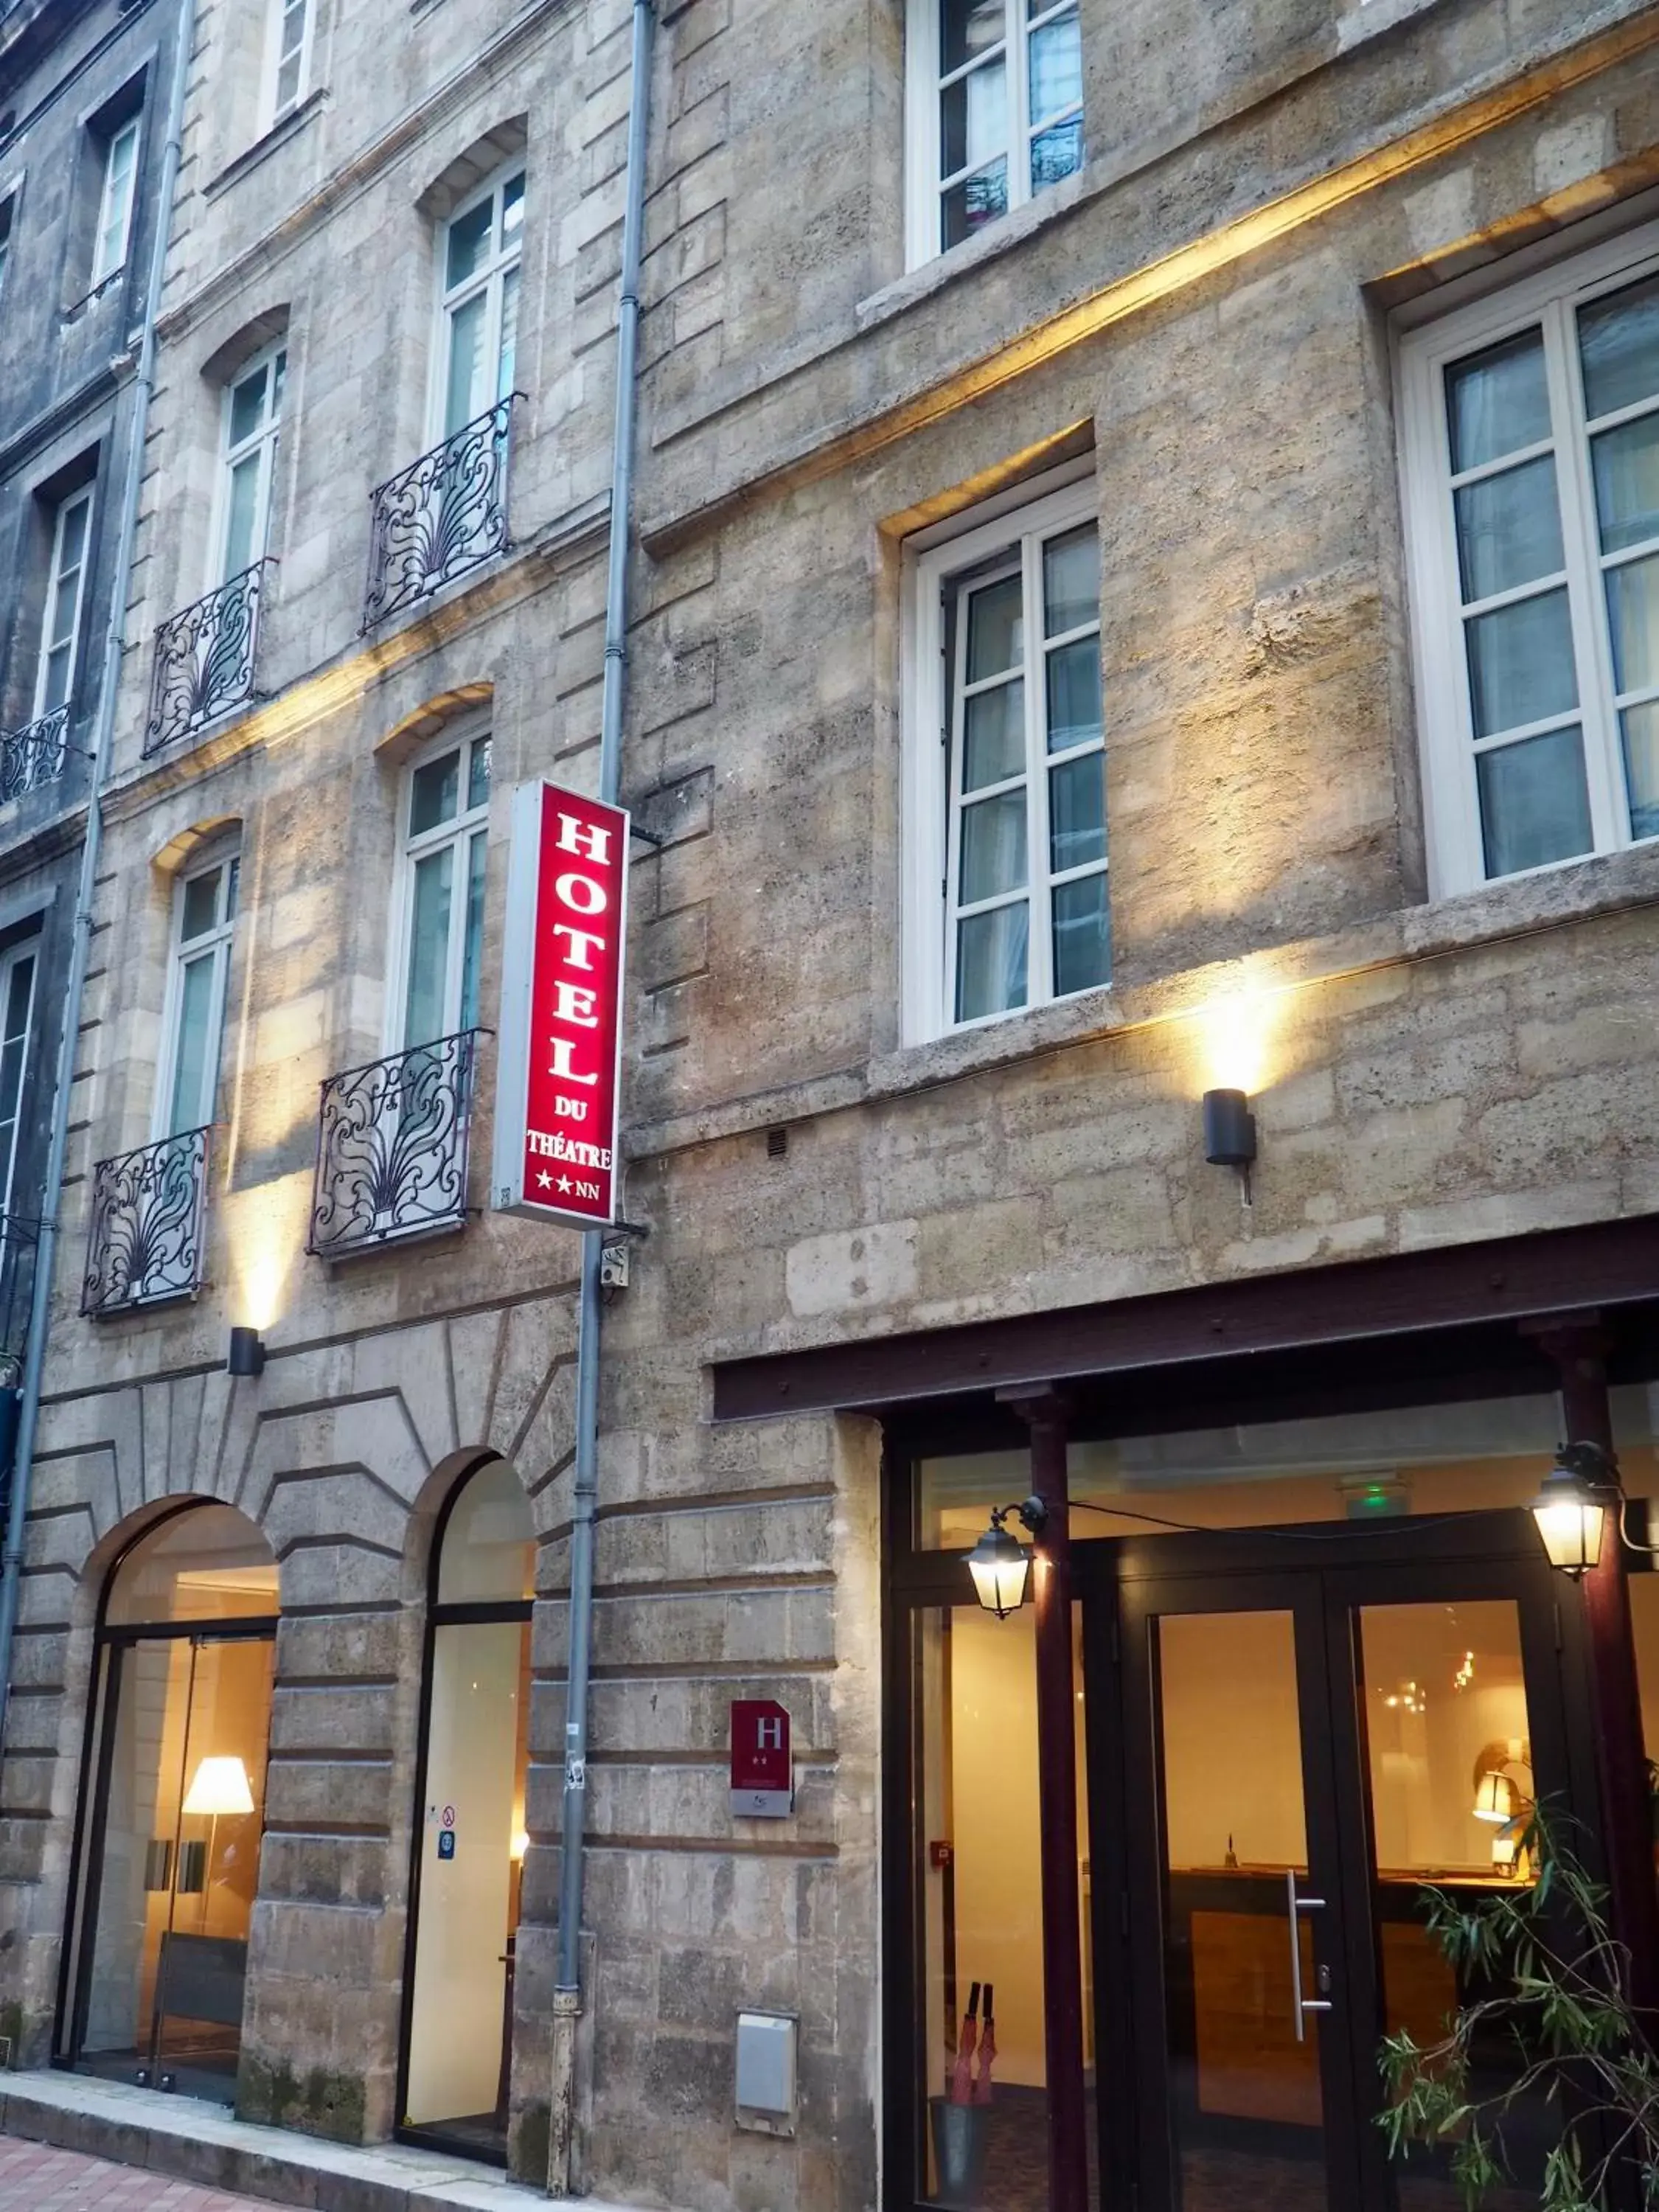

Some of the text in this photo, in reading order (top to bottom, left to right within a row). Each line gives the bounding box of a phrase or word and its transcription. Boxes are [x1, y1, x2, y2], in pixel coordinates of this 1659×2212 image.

[549, 813, 611, 1085] HOTEL
[554, 1096, 587, 1121] DU
[527, 1129, 611, 1170] THÉATRE
[574, 1180, 600, 1200] NN
[757, 1717, 782, 1749] H
